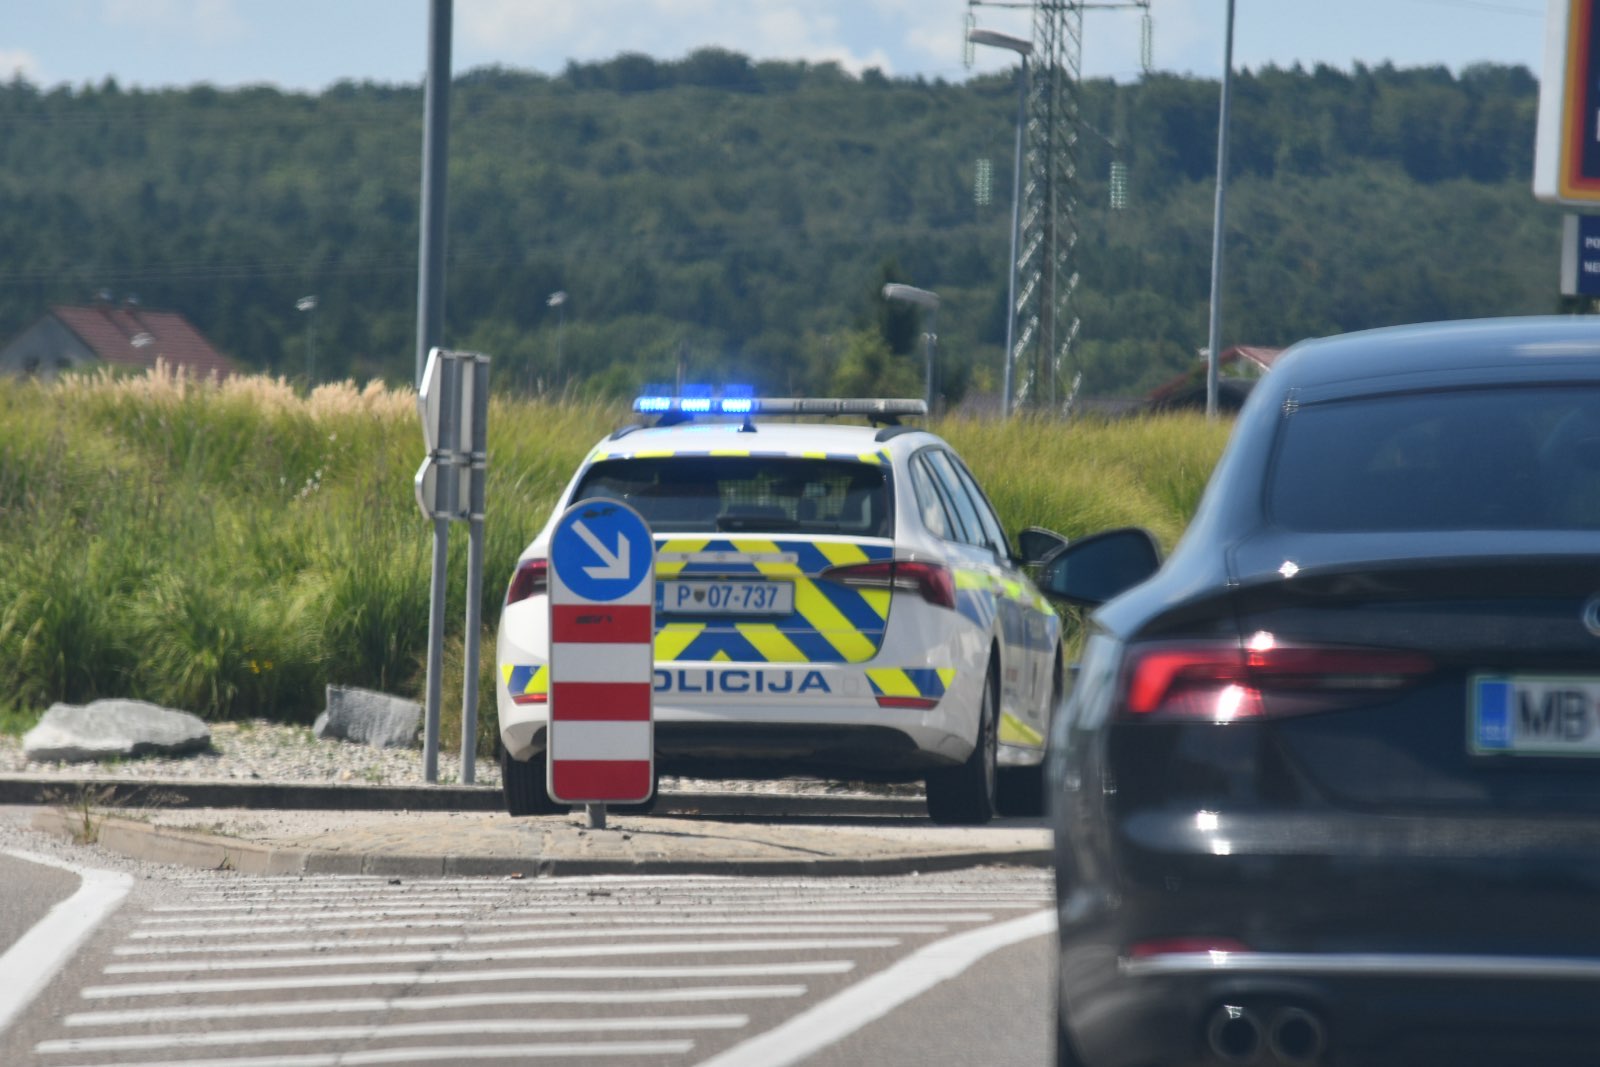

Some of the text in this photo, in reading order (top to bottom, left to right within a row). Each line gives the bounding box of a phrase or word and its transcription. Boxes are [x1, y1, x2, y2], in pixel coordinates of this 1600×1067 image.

[677, 585, 778, 609] P 07-737
[653, 669, 832, 694] OLICIJA
[1517, 688, 1590, 742] MB
